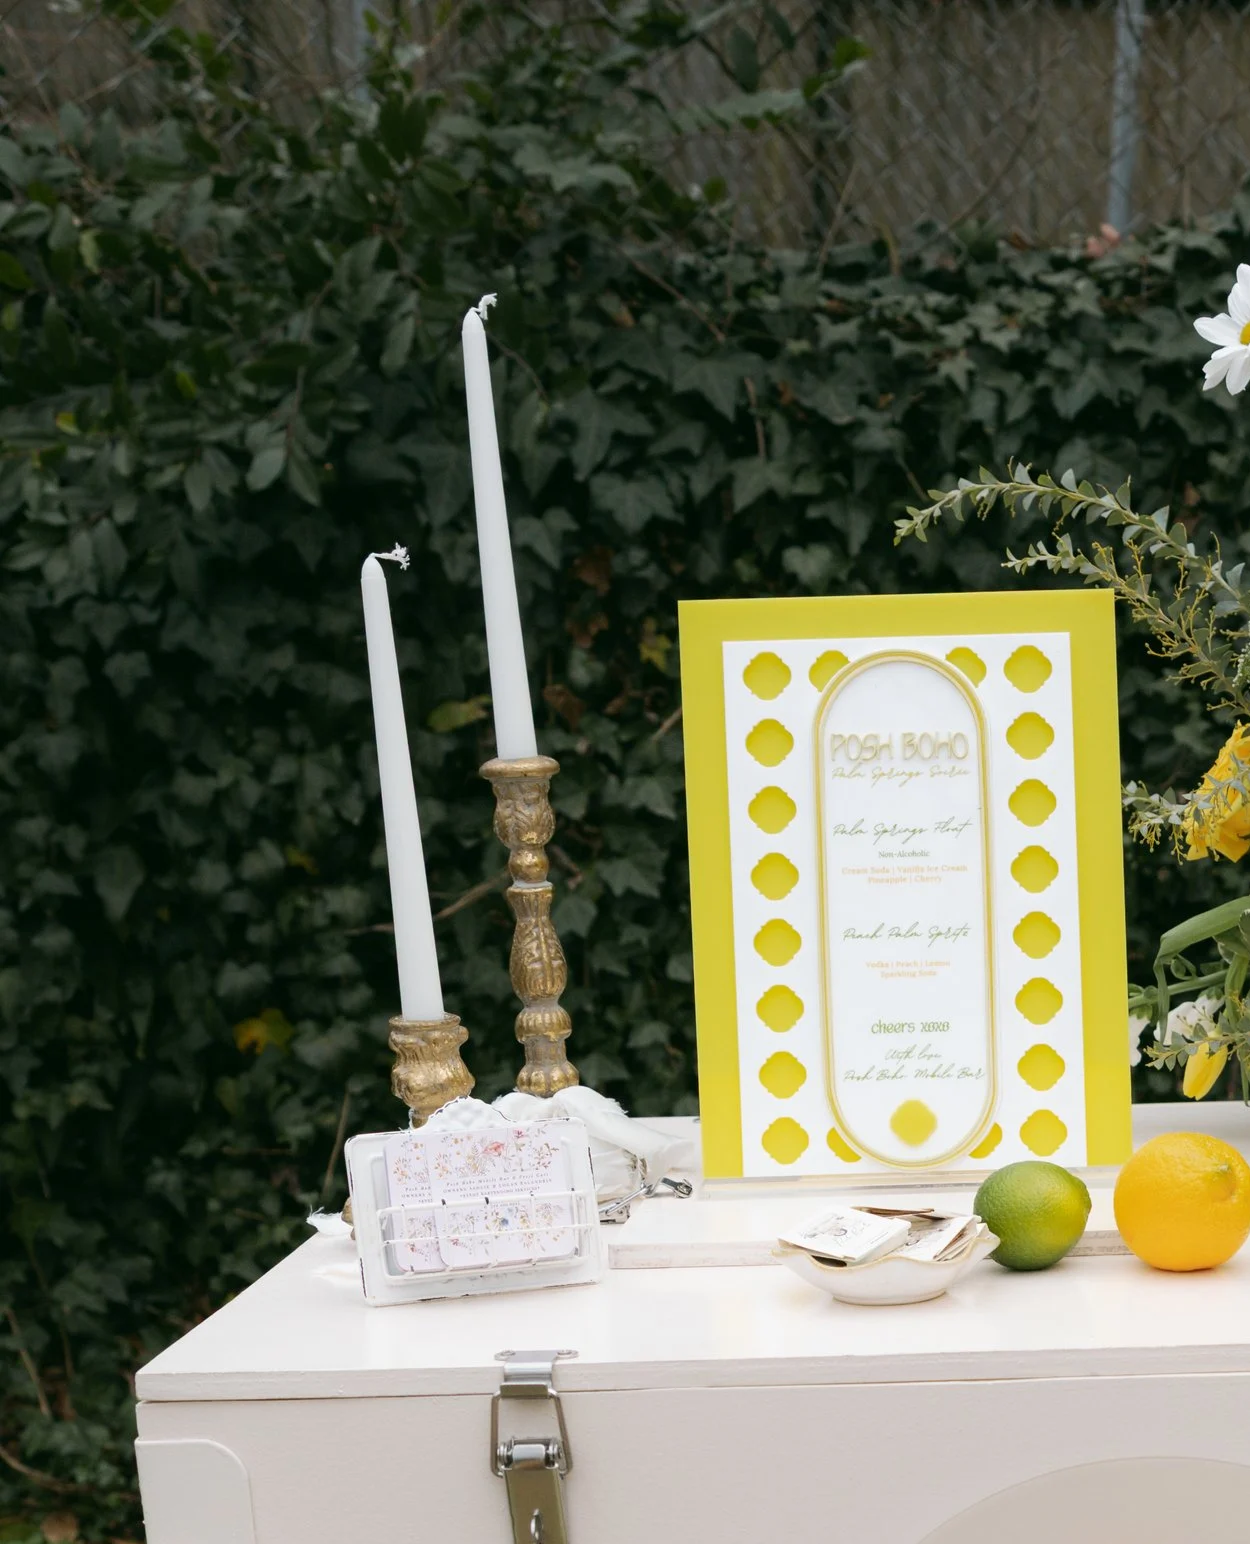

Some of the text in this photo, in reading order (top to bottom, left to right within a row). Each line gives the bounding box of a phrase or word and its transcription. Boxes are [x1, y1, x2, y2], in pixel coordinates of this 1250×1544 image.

[829, 731, 970, 762] POSH BOHO
[870, 766, 924, 788] Springs
[832, 818, 869, 837] Palm
[872, 823, 928, 846] Springs
[878, 849, 931, 860] Non-Alcoholic
[870, 865, 890, 874] Soda
[897, 865, 924, 874] Vanilla
[940, 864, 968, 873] Cream
[868, 875, 942, 886] Pineapple Cherry
[865, 960, 890, 969] Vodka
[870, 1019, 916, 1035] cheers
